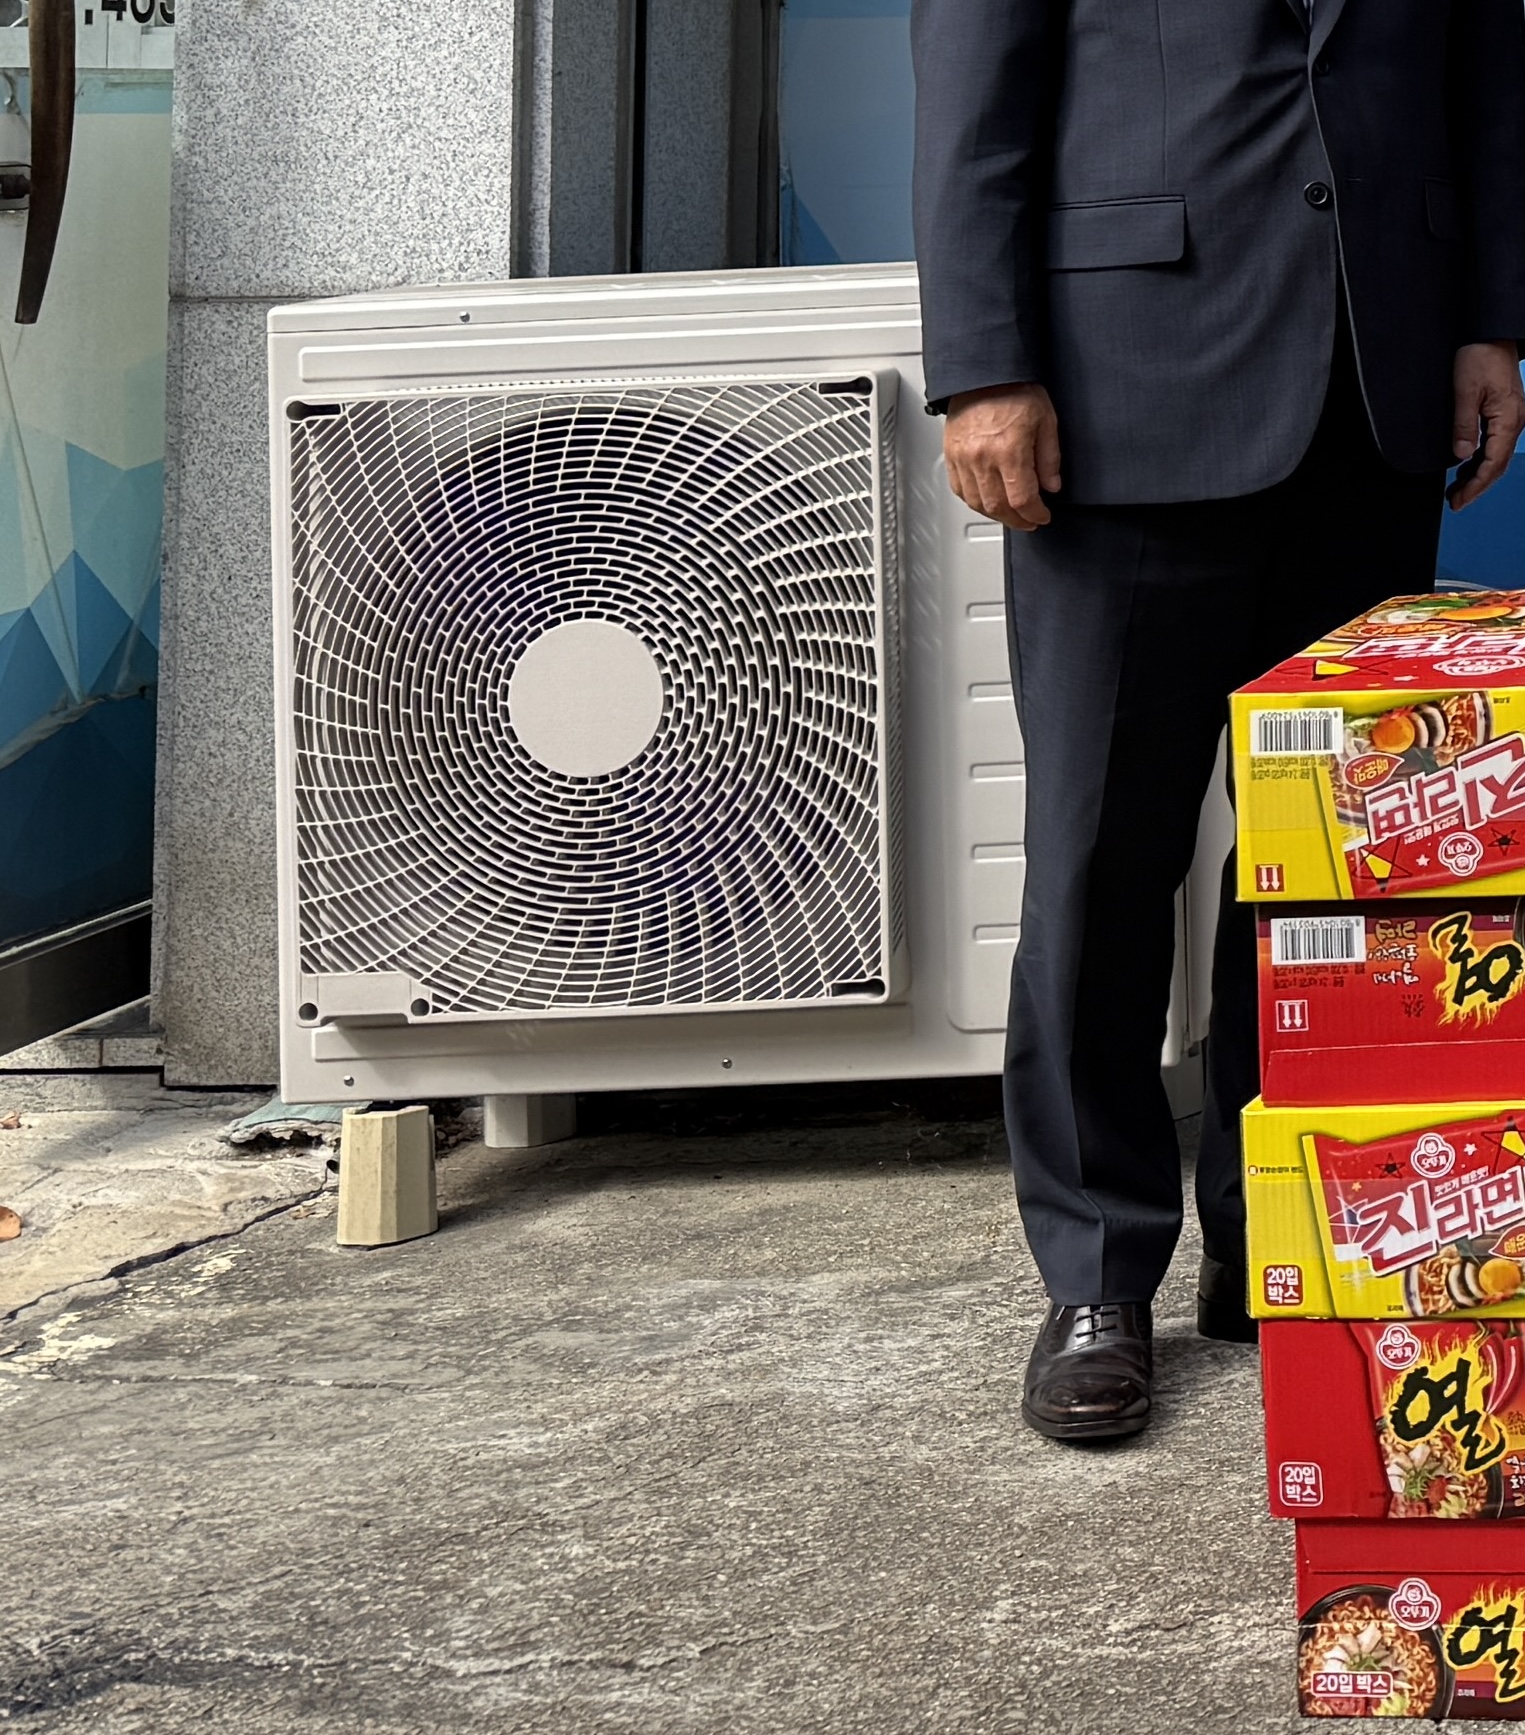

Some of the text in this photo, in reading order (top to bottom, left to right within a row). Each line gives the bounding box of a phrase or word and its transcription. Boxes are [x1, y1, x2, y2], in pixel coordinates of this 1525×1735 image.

[1350, 758, 1390, 785] 매운맛
[1430, 913, 1523, 1006] 열
[1267, 1267, 1299, 1285] 20입
[1267, 1285, 1300, 1304] 박스
[1391, 1358, 1505, 1470] 열
[1284, 1466, 1316, 1485] 20입
[1285, 1484, 1318, 1504] 박스
[1400, 1605, 1430, 1619] 오뚜기
[1316, 1674, 1389, 1694] 20입 박스
